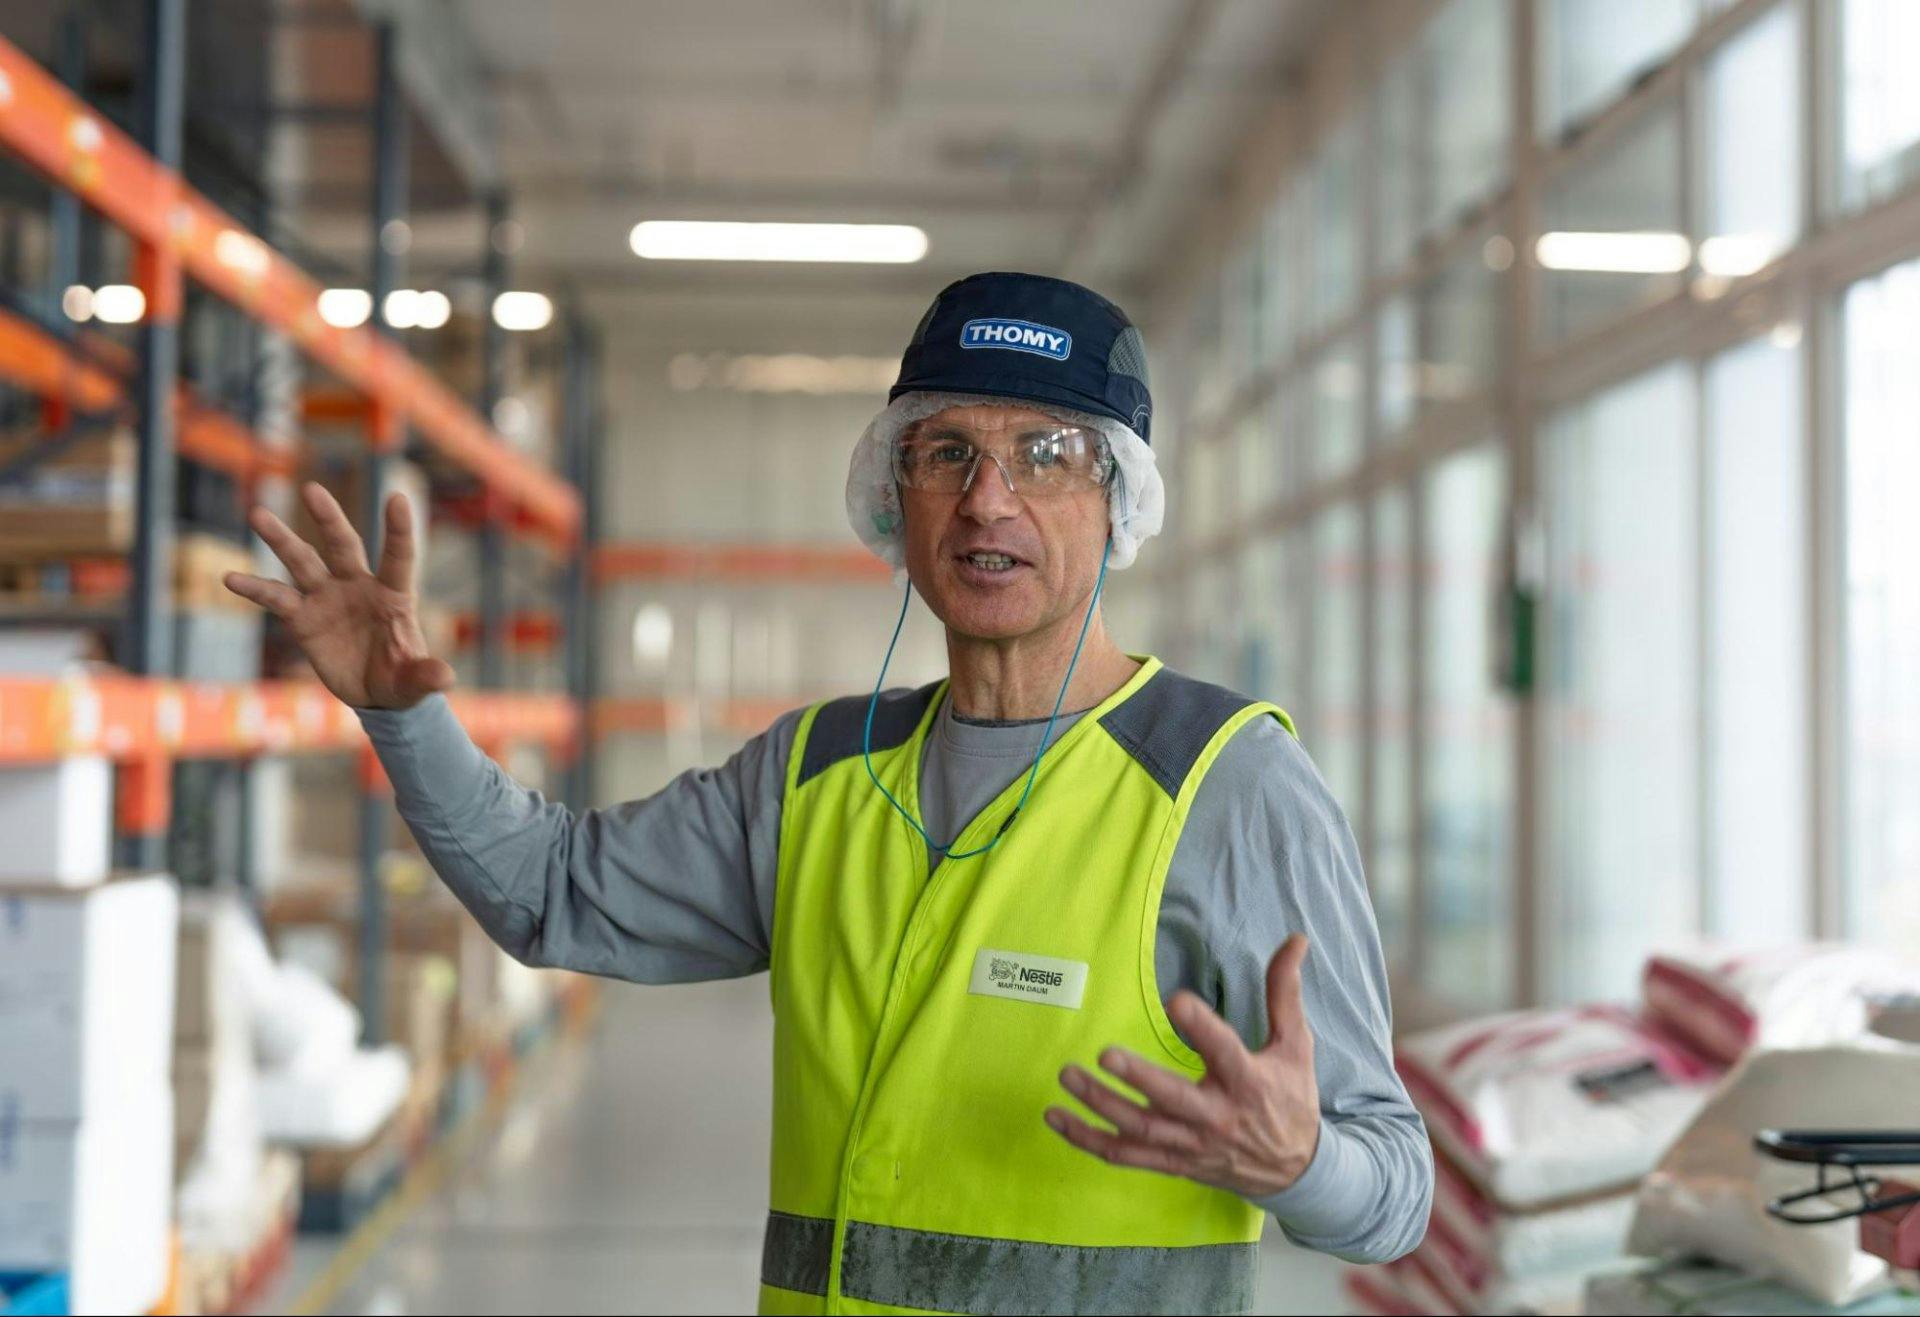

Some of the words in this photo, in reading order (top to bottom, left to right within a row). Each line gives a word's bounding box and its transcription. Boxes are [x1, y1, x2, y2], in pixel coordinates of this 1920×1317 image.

[969, 325, 1064, 351] THOMY
[997, 981, 1025, 992] MARTIN
[1026, 985, 1048, 995] DAUM
